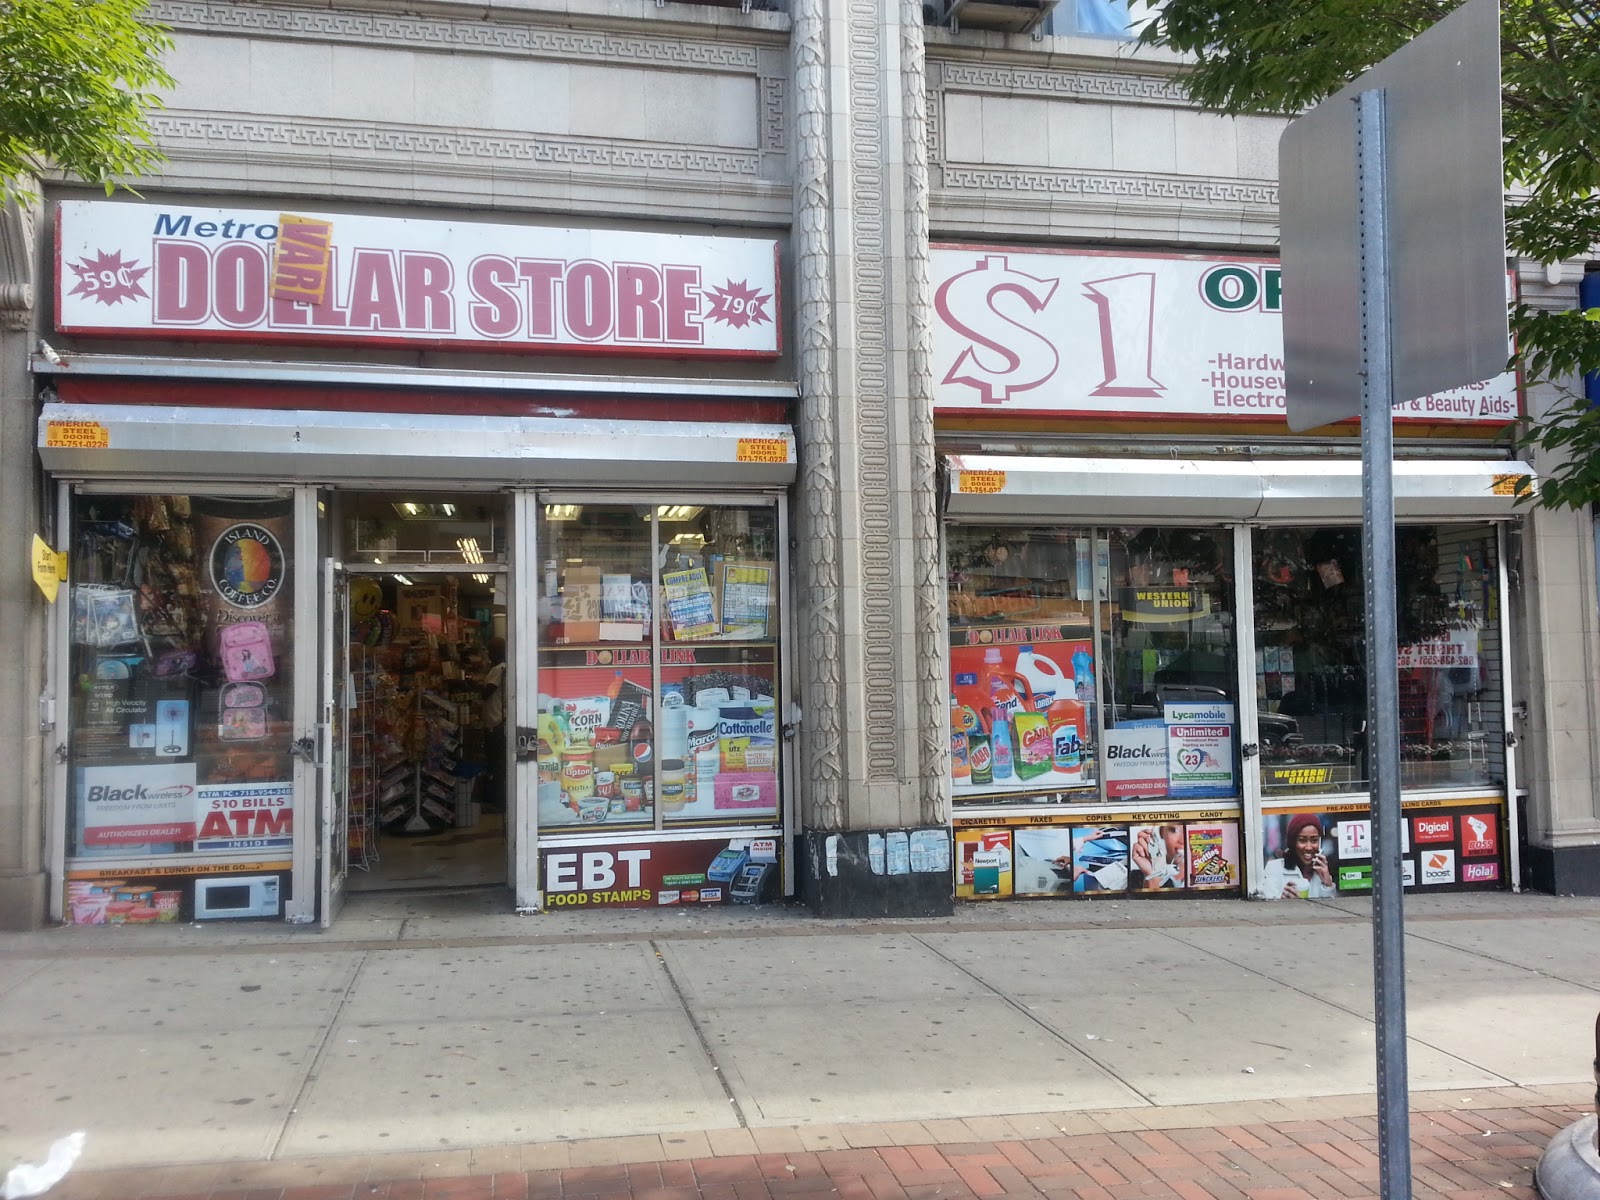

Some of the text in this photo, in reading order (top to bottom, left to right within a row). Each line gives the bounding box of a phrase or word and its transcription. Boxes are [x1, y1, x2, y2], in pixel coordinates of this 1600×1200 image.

[154, 213, 278, 239] Metro
[84, 265, 135, 291] 59¢
[467, 253, 704, 345] STORE
[721, 294, 760, 320] 79¢
[934, 255, 1168, 404] $1
[1426, 394, 1476, 416] Beauty
[47, 440, 108, 448] 973-751-0226
[224, 528, 270, 545] ISLAND
[219, 579, 261, 604] COFFEE
[1136, 591, 1189, 601] WESTERN
[1153, 600, 1189, 608] UNION
[217, 609, 270, 623] Discover
[1030, 625, 1063, 641] LINK
[661, 648, 697, 665] LINK
[121, 699, 147, 707] Velocity
[574, 713, 602, 727] CORN
[1172, 710, 1226, 720] Lycamobile
[720, 721, 772, 735] Cottonelle
[1177, 727, 1223, 737] Unlimited
[687, 729, 718, 748] Marcal
[1022, 727, 1049, 748] GAIN
[1055, 734, 1081, 756] Fab
[1107, 744, 1152, 760] Black
[565, 768, 590, 778] Lipton
[1274, 768, 1326, 779] WESTERN
[1288, 775, 1325, 784] UNION
[87, 784, 183, 802] Black wireless
[96, 803, 130, 812] FREEDOM
[212, 797, 285, 810] $10 BILLS
[198, 808, 294, 839] ATM
[961, 817, 1007, 826] CIGARETTES
[1148, 812, 1180, 820] CUTTING
[97, 828, 182, 839] AUTHORIZED DEALER
[1418, 821, 1449, 835] Digicel
[228, 840, 268, 848] INSIDE
[1468, 839, 1494, 850] BOSS
[975, 858, 997, 866] Newport
[1193, 848, 1220, 869] Skittles
[99, 868, 152, 877] BREAKFAST
[164, 866, 194, 874] LUNCH
[213, 864, 231, 872] THE
[547, 849, 651, 893] EBT
[1426, 869, 1451, 878] boost
[547, 889, 651, 906] FOOD STAMPS
